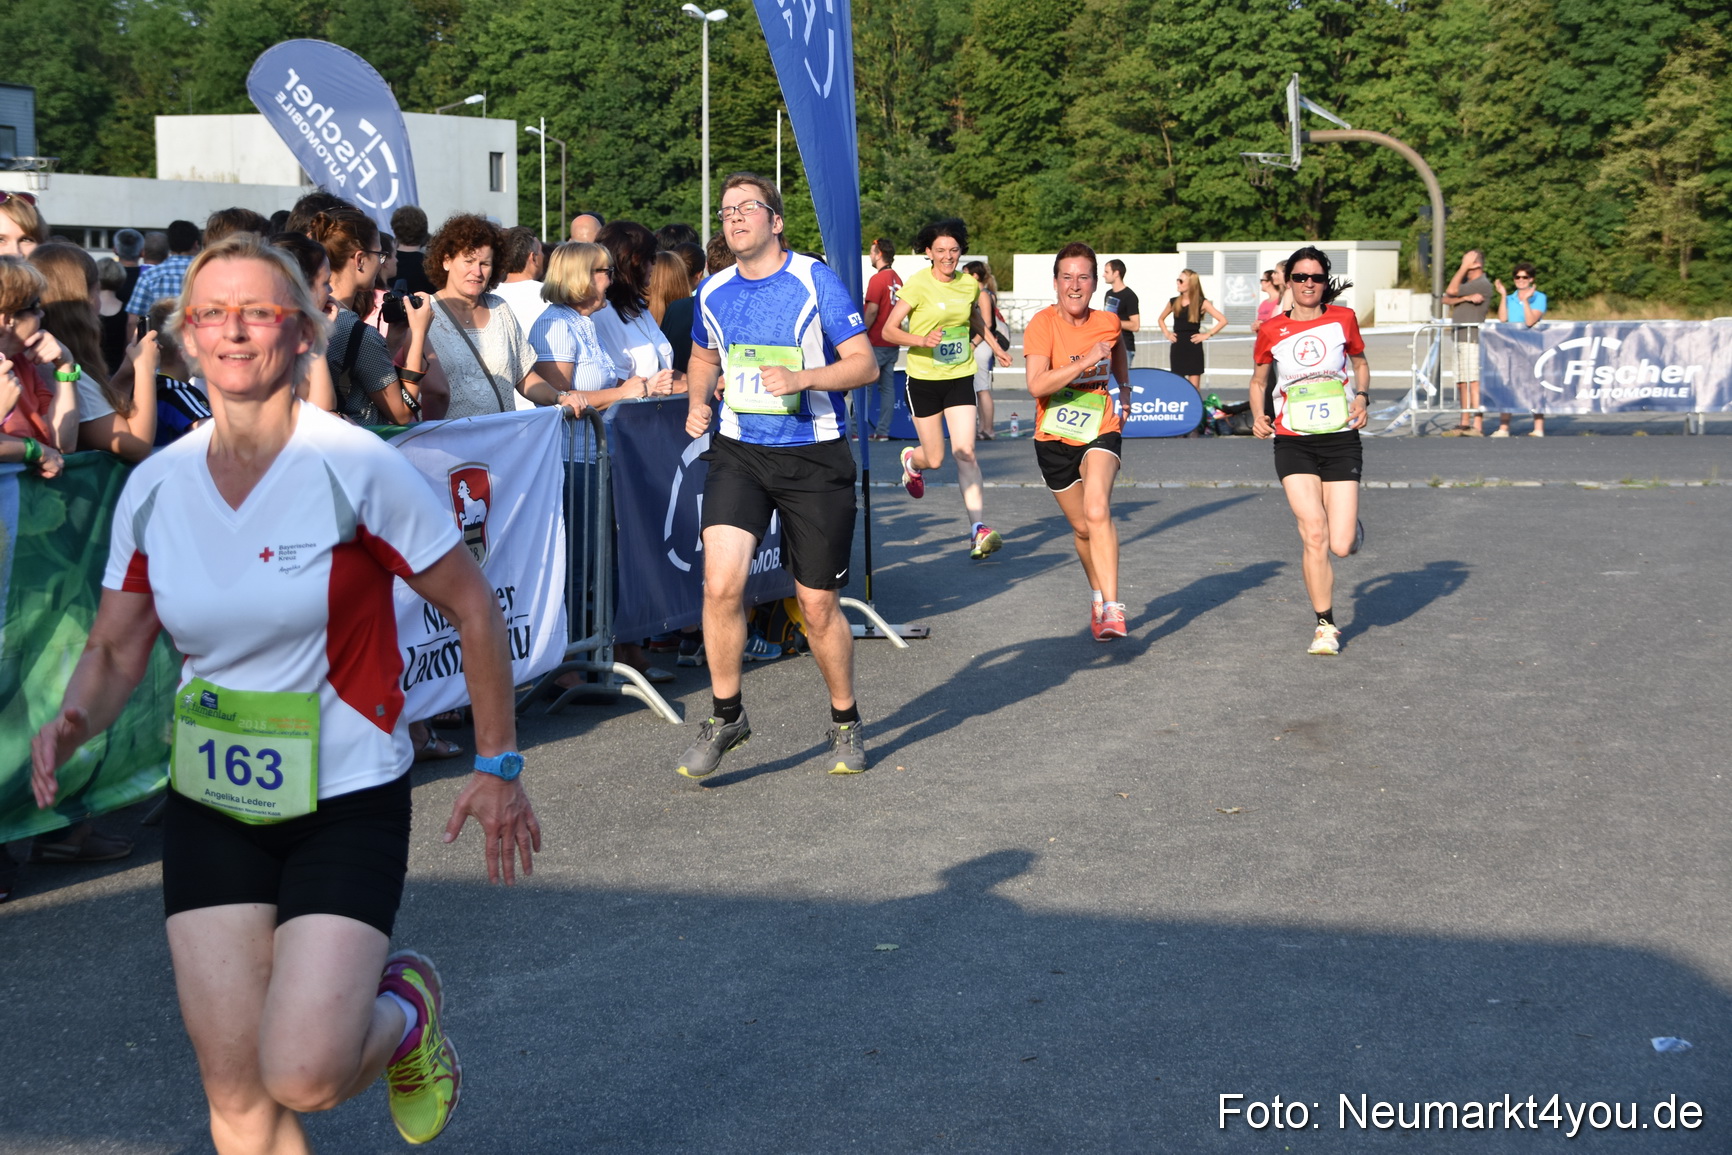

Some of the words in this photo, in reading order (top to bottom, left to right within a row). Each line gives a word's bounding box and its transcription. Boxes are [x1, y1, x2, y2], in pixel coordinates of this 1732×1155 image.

[940, 342, 963, 356] 628
[1563, 358, 1703, 385] Fischer
[735, 372, 773, 395] 11
[402, 389, 417, 408] SONY
[1576, 386, 1690, 400] AUTOMOBILE
[1114, 398, 1189, 415] Fscher
[1306, 402, 1330, 420] 75
[1056, 407, 1092, 428] 627
[278, 543, 317, 551] Bayerisches
[238, 718, 268, 730] 2015
[198, 738, 284, 791] 163
[204, 788, 241, 804] Angelika
[241, 796, 277, 809] Lederer
